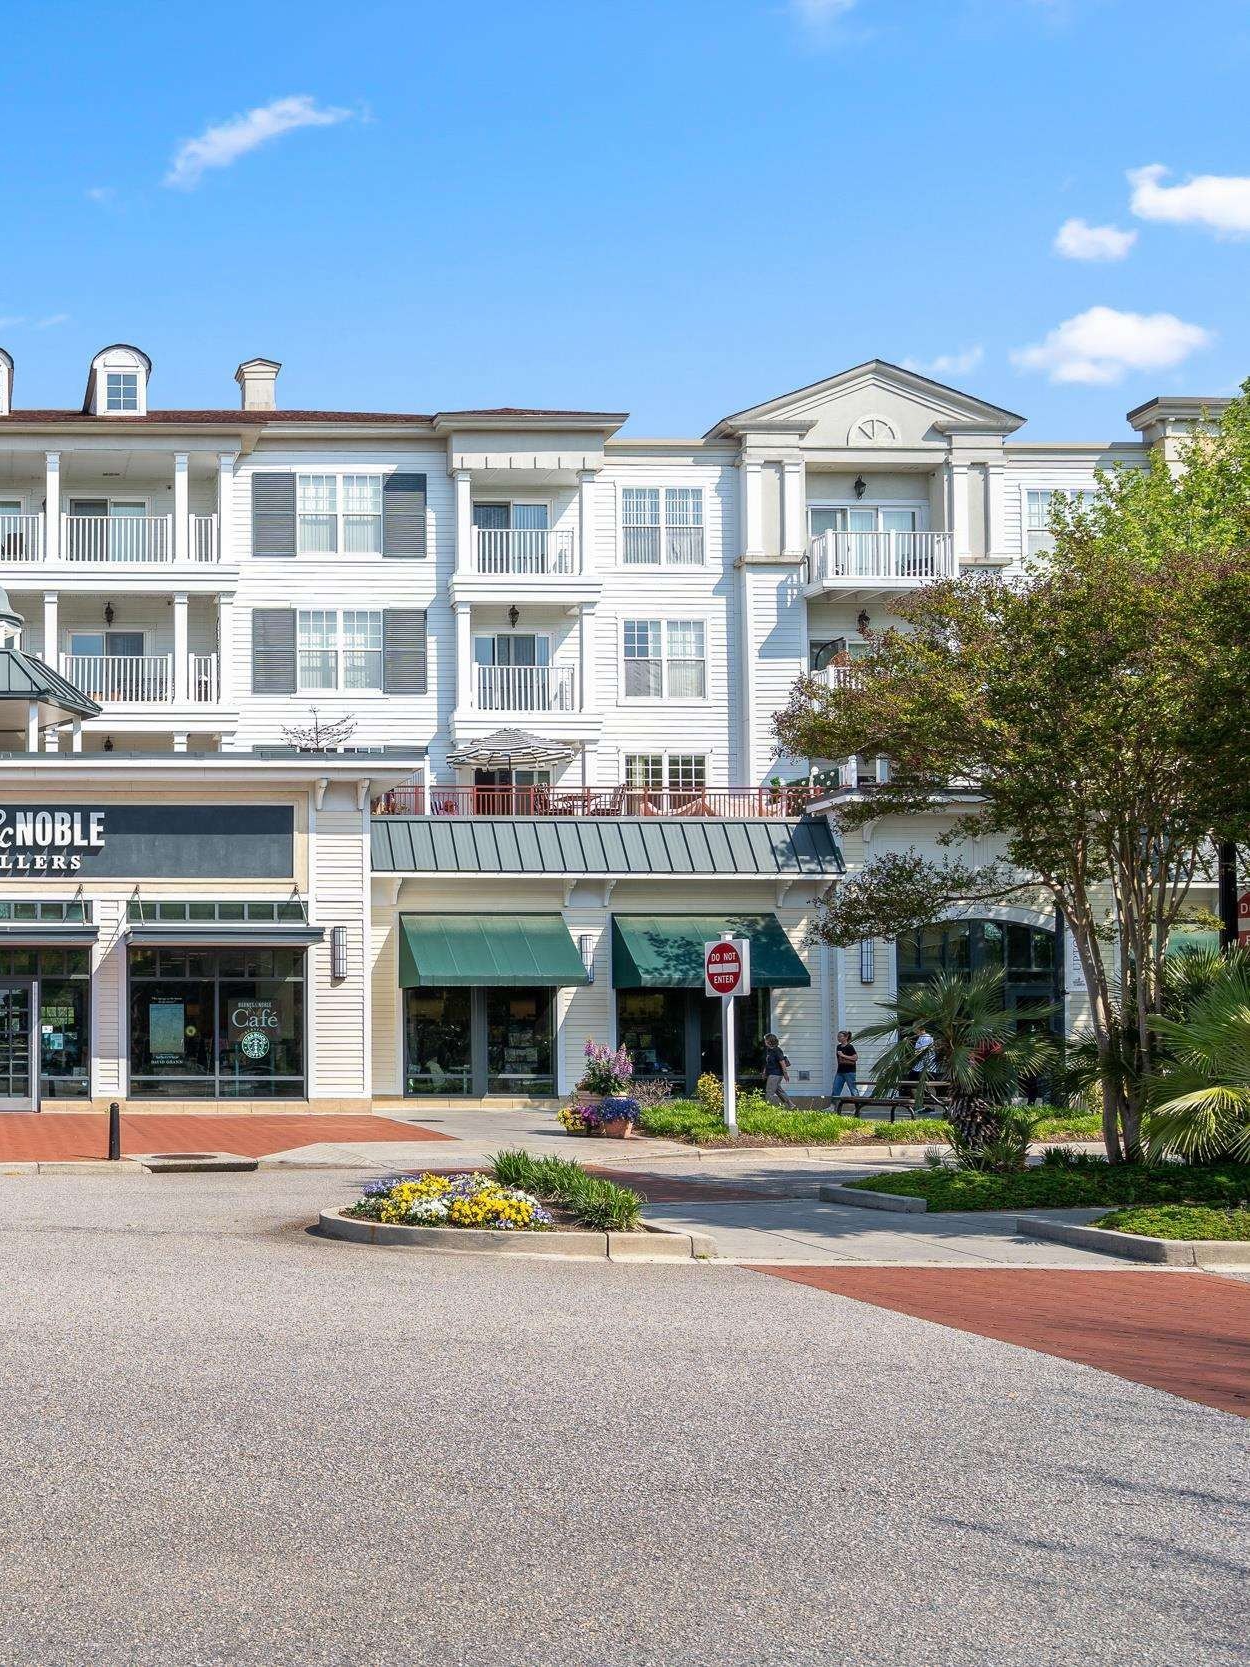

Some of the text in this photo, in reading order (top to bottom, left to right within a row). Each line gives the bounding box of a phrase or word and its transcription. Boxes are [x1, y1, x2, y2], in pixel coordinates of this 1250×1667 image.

[1240, 903, 1250, 914] D
[711, 952, 736, 962] DO NOT
[713, 974, 734, 984] ENTER
[231, 1008, 279, 1028] Café
